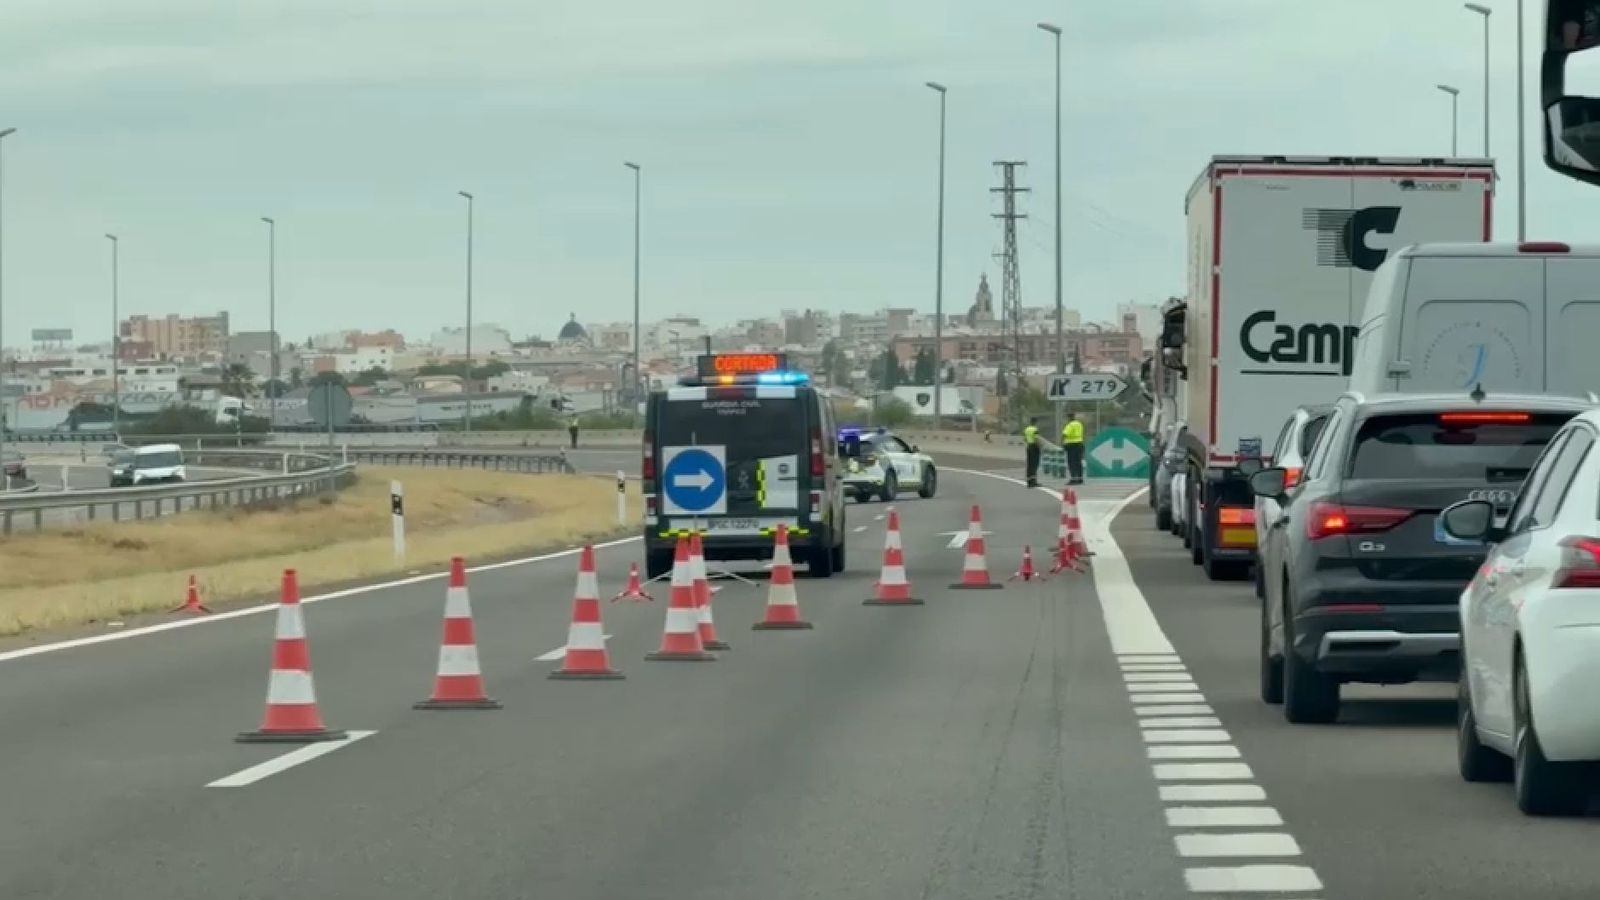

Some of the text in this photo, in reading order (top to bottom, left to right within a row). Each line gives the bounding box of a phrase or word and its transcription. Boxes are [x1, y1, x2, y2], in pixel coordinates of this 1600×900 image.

[715, 354, 778, 371] CORTADA
[1081, 380, 1117, 393] 279
[1359, 541, 1386, 552] Q3
